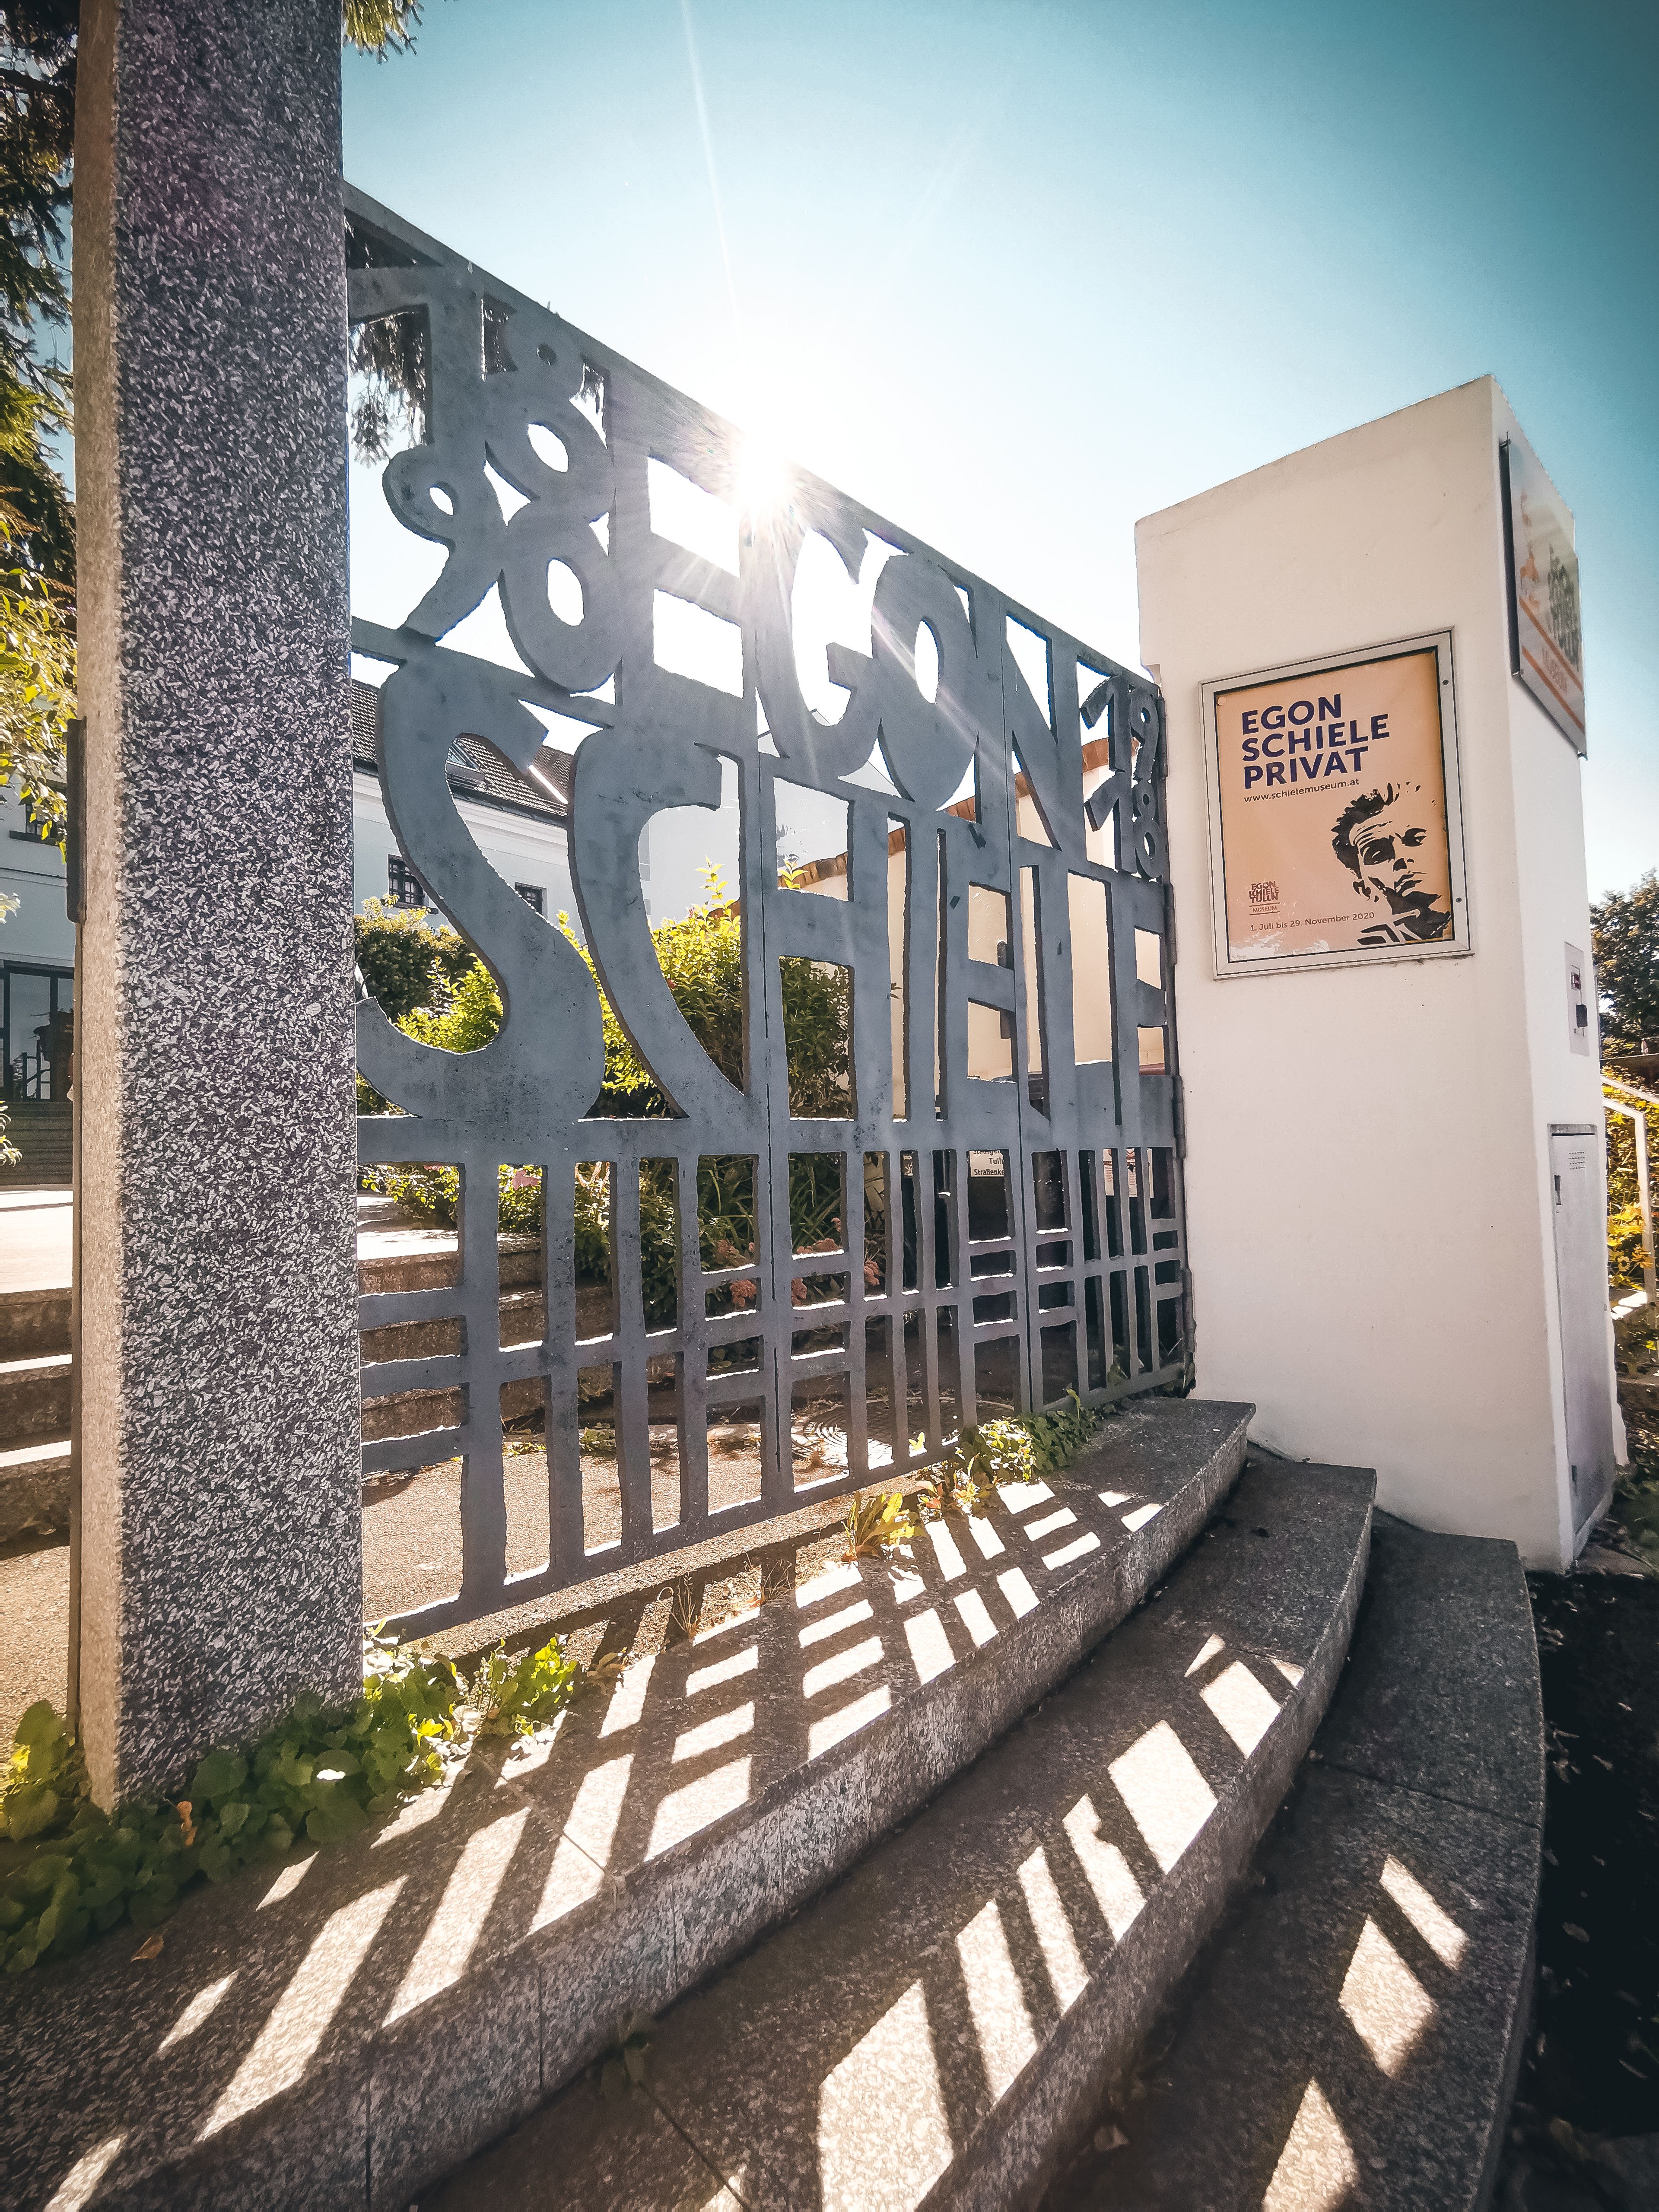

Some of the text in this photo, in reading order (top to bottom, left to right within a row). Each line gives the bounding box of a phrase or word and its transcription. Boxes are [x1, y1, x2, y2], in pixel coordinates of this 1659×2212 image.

[607, 359, 1080, 858] EGON
[1242, 693, 1341, 735] EGON
[1242, 713, 1390, 762] SCHIELE
[1244, 746, 1368, 790] PRIVAT
[1244, 778, 1360, 803] www.schielemuseum.at
[352, 646, 1176, 1123] SCHIELE
[1250, 893, 1278, 903] TULLN
[1251, 880, 1276, 890] EGON
[1290, 919, 1303, 928] 29.
[1305, 915, 1350, 926] November
[1352, 912, 1375, 921] 2020
